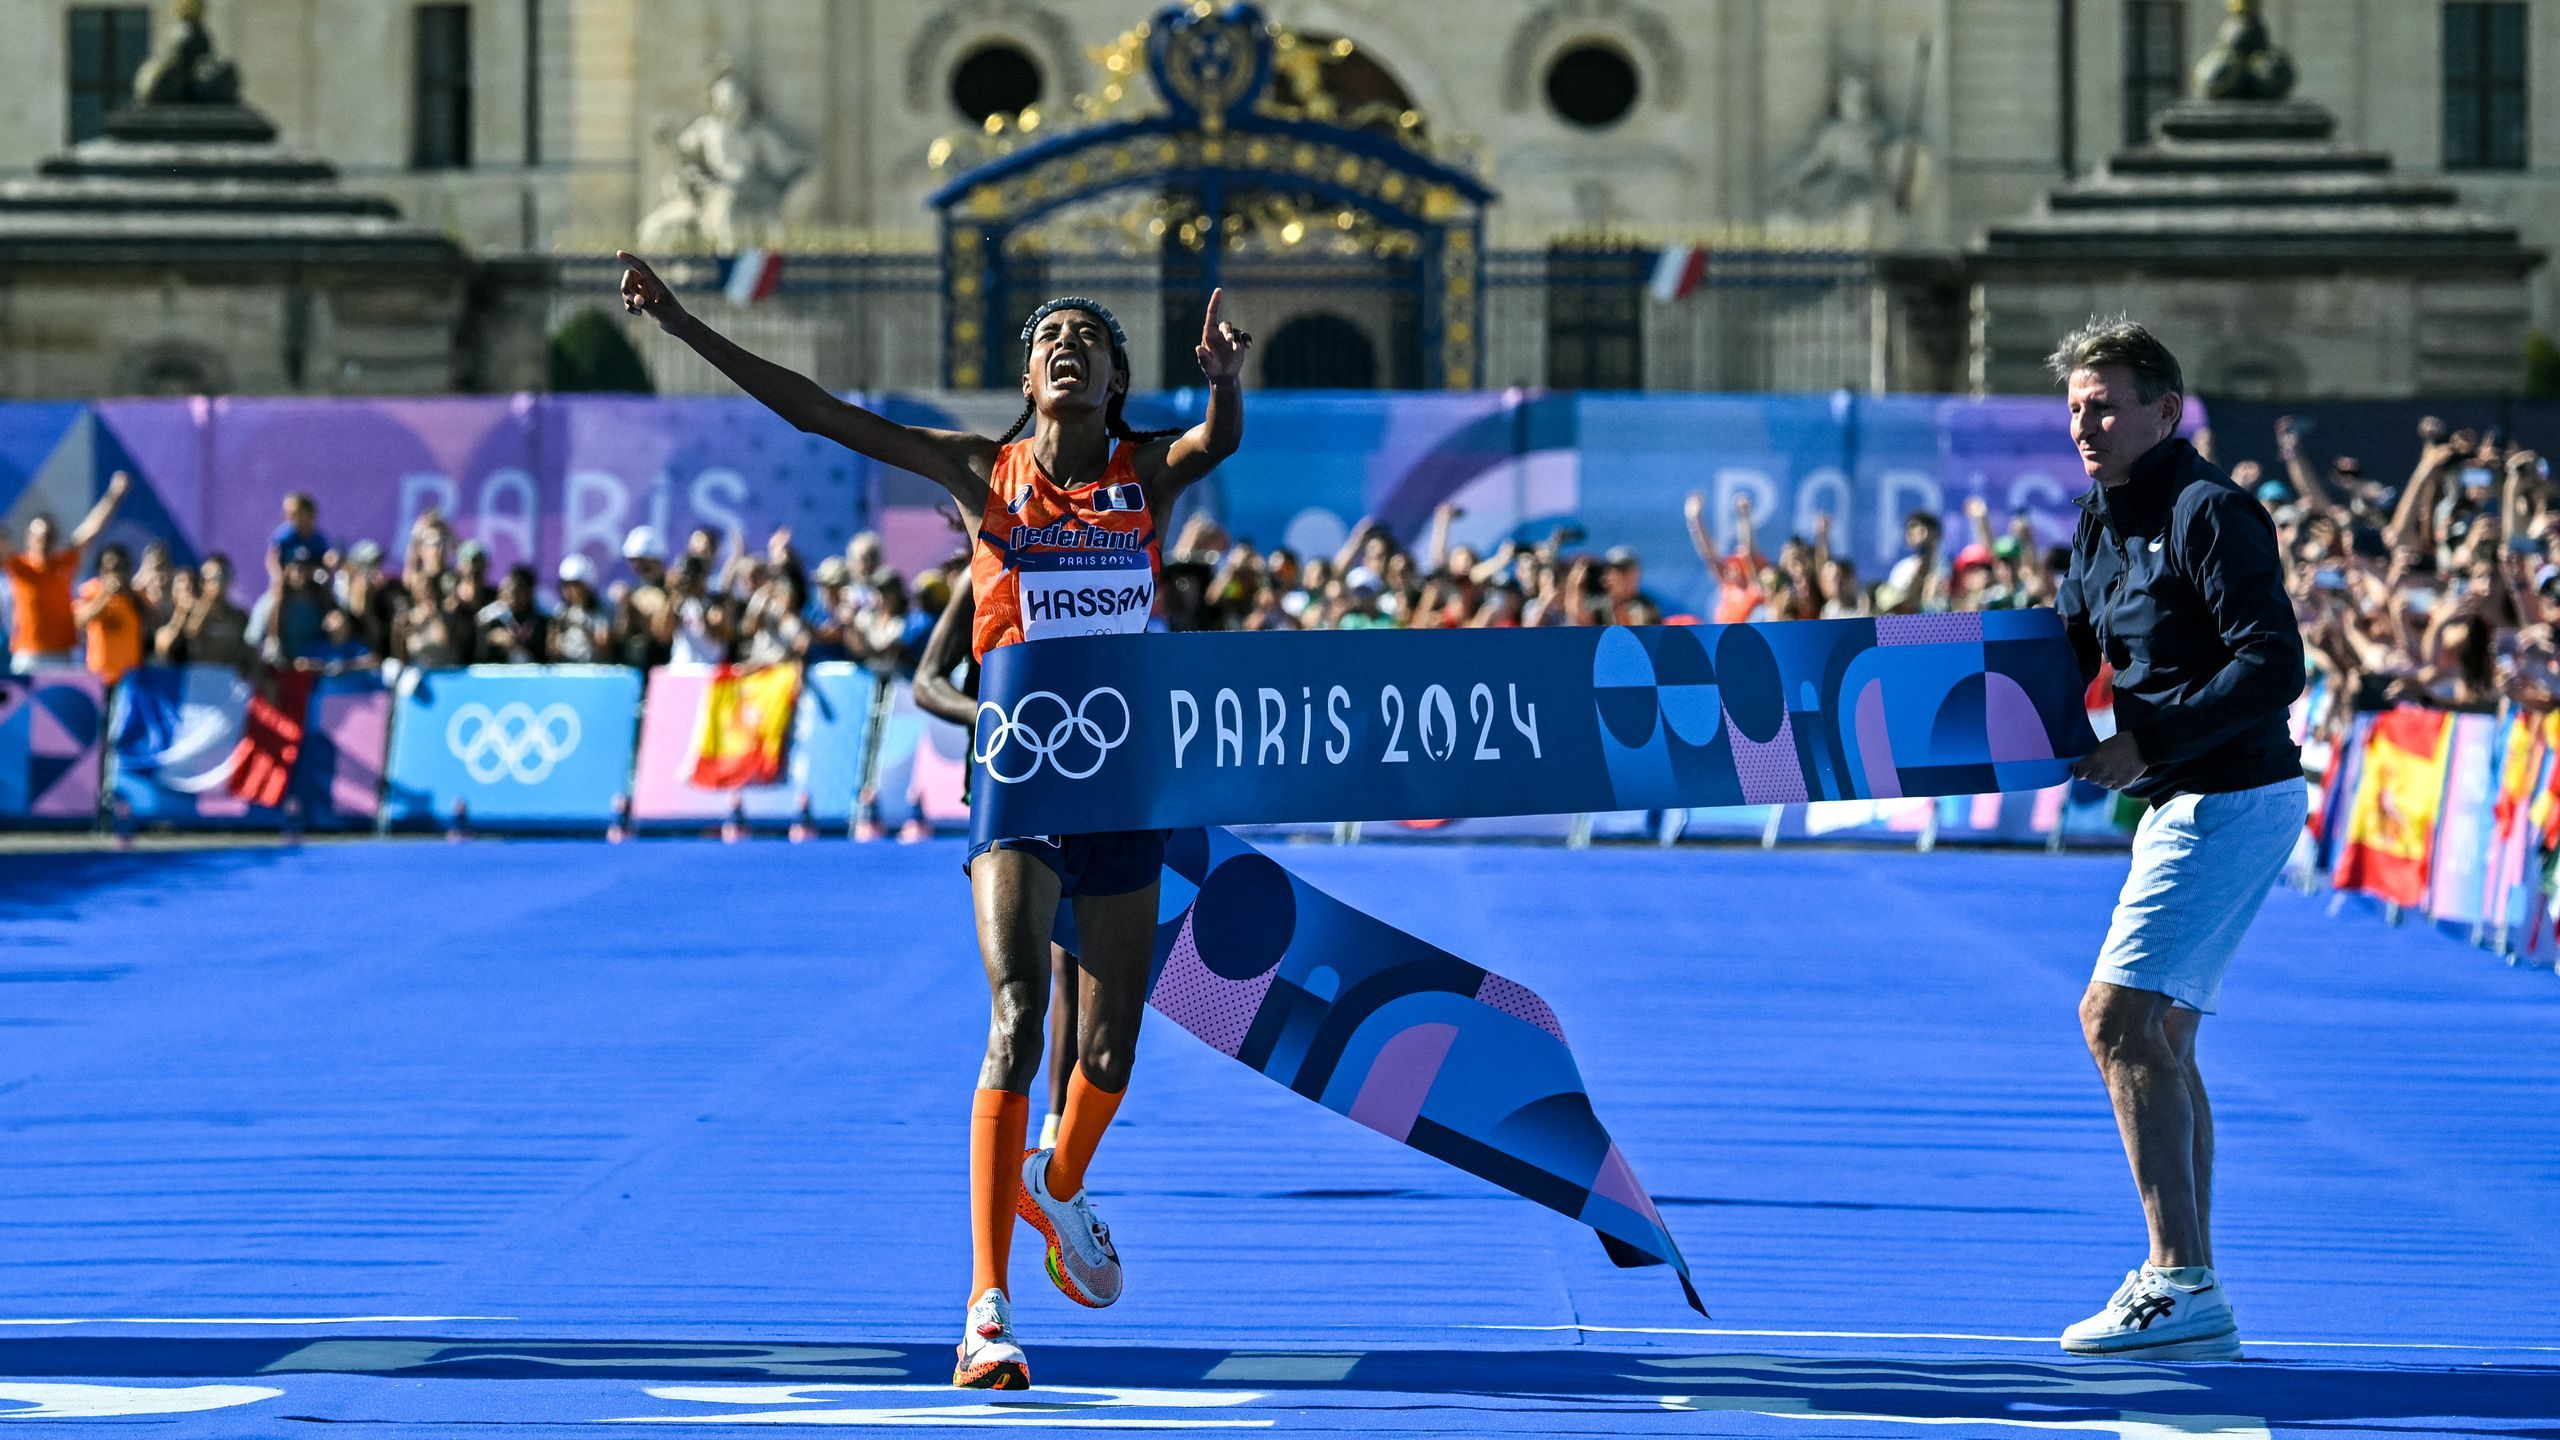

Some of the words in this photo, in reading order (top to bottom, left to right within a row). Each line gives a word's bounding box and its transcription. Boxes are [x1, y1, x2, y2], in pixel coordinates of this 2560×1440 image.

[1101, 555, 1133, 565] 2024
[1027, 582, 1153, 621] HASSAN
[1380, 682, 1542, 763] 2024
